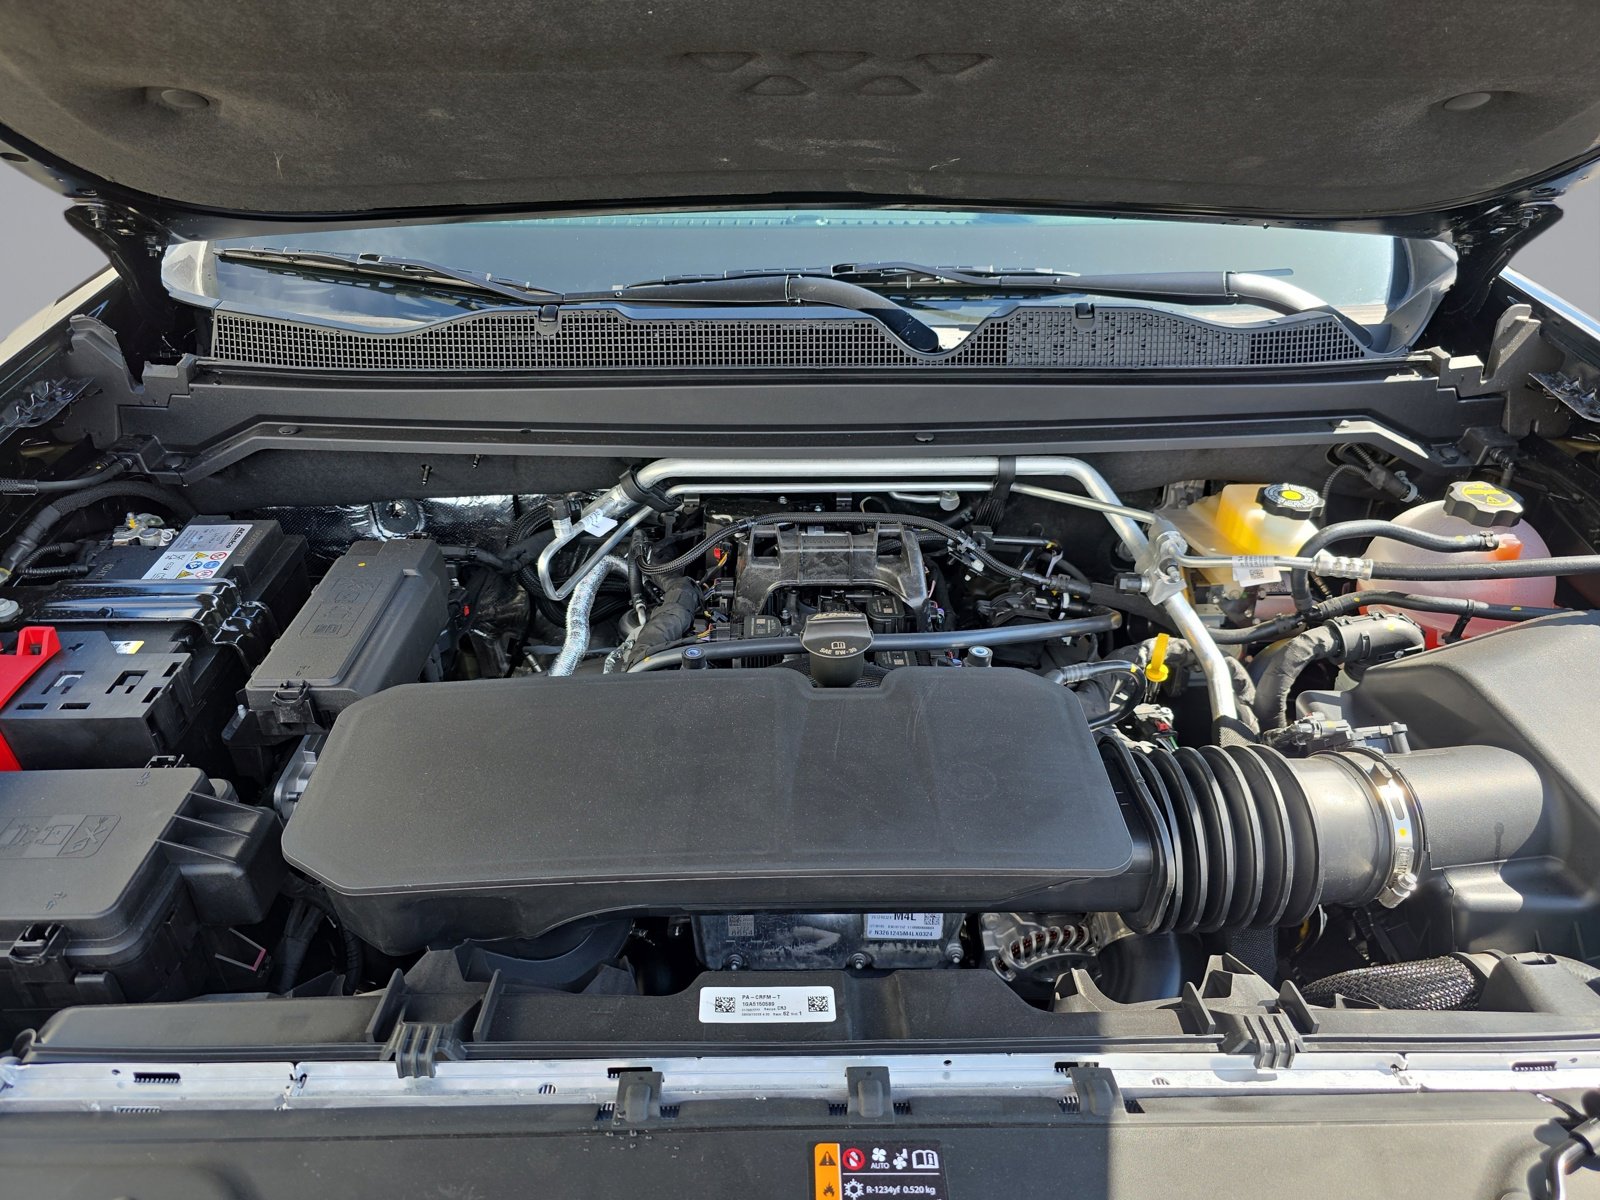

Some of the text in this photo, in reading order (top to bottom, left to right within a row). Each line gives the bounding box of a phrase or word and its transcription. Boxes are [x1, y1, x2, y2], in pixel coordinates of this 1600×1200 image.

[866, 1185, 936, 1196] R-1234yf 0.520 kg
